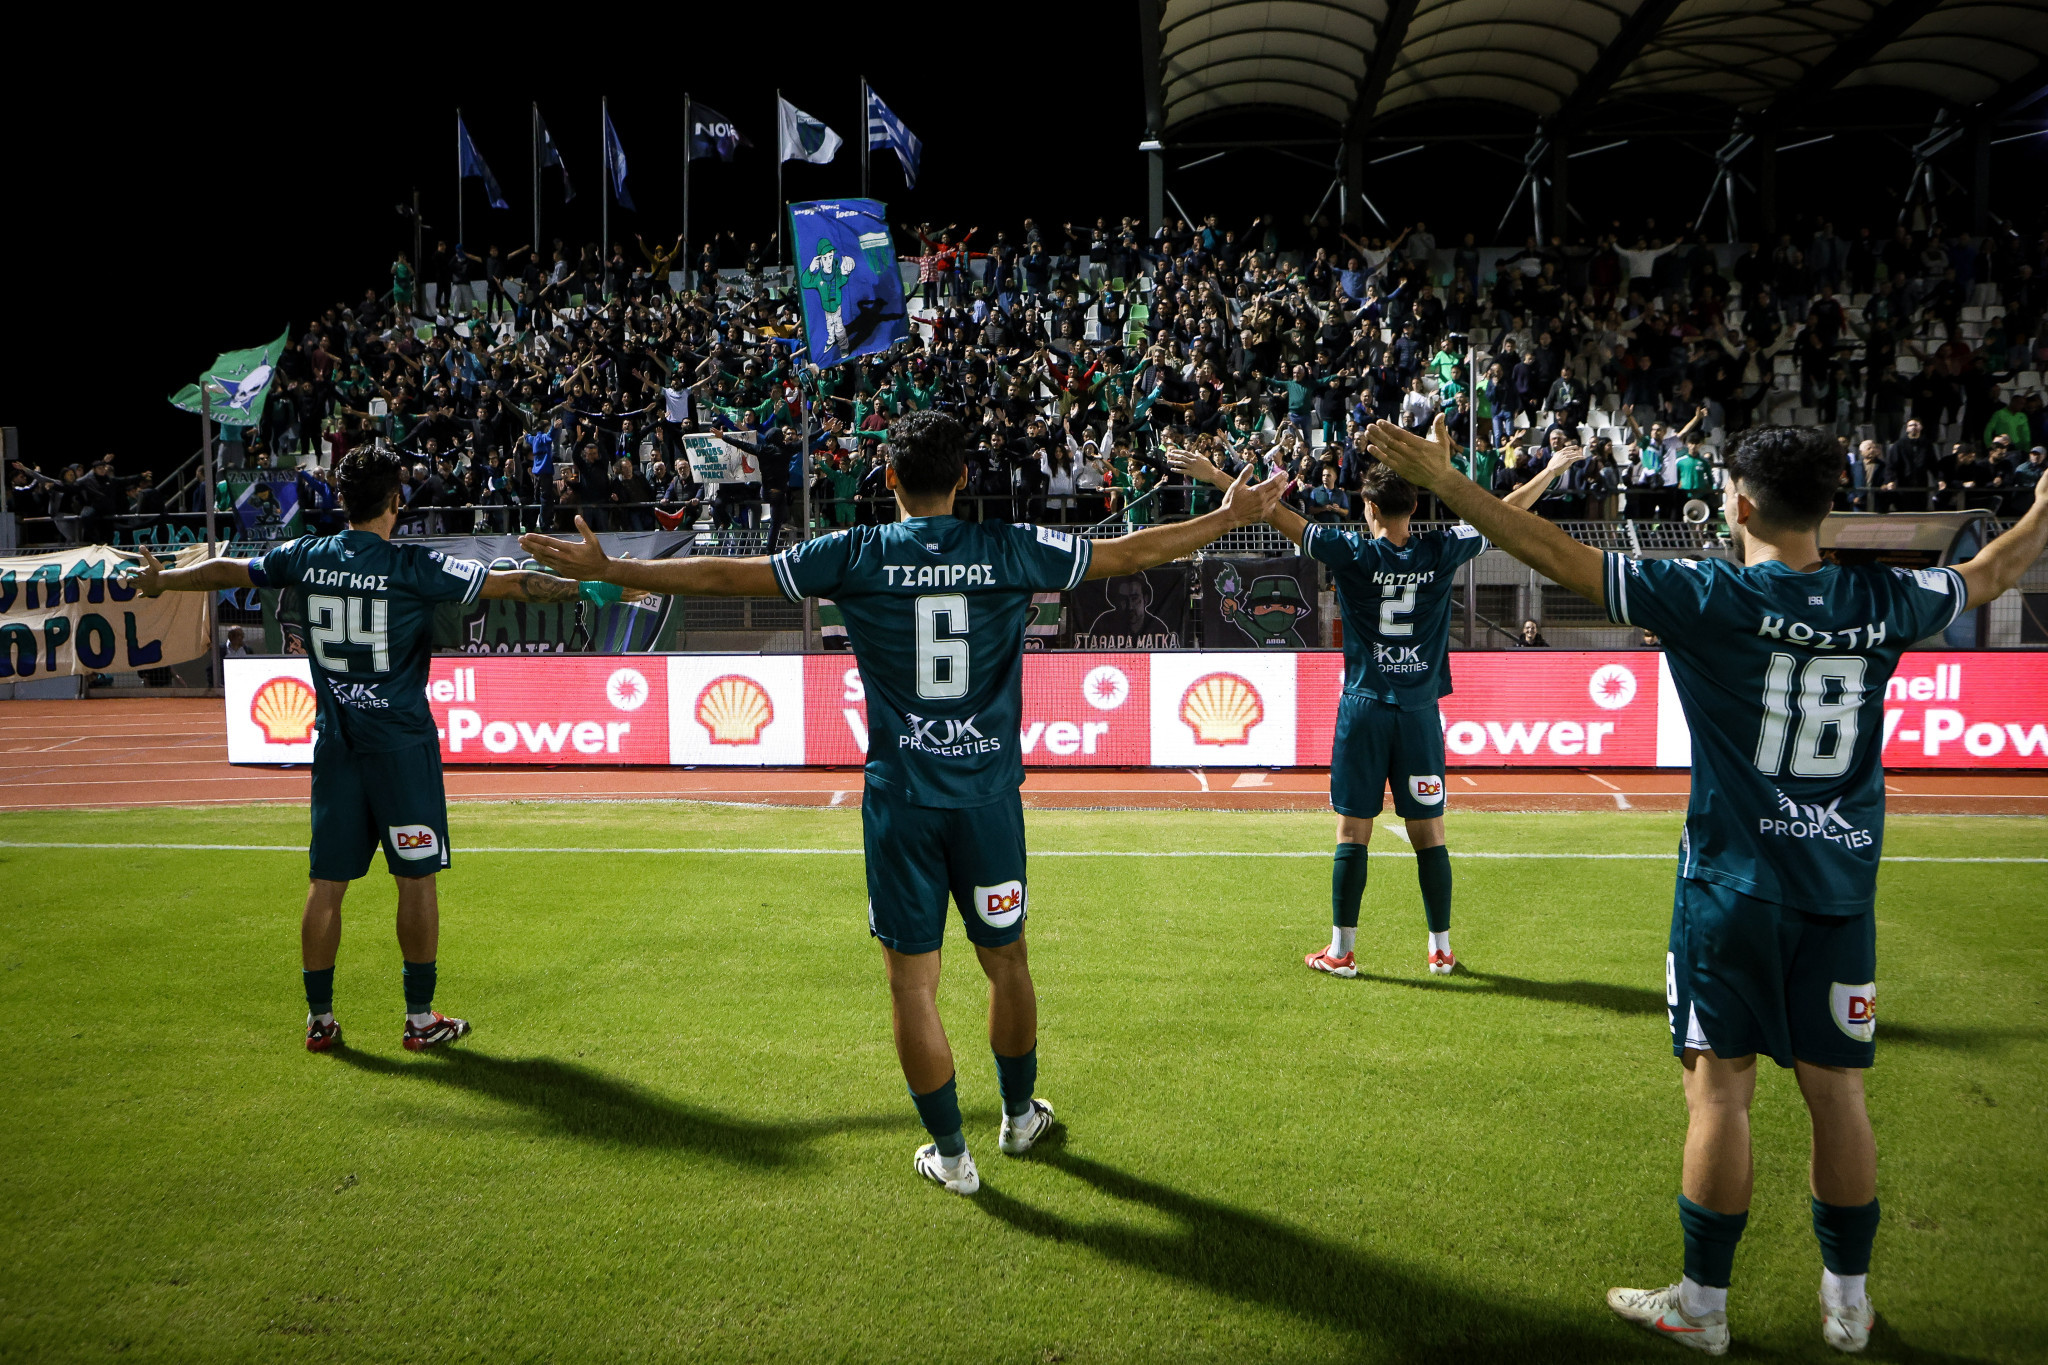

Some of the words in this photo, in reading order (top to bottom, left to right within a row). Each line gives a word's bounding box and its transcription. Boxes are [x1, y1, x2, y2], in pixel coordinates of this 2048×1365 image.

[302, 567, 389, 592] ΛΙΑΓΚΑΣ
[883, 564, 996, 587] ΤΣΑΠΡΑΣ
[1379, 583, 1418, 637] 2
[307, 593, 391, 674] 24
[915, 593, 970, 700] 6
[1757, 615, 1886, 650] ΚΩΣΤΗ
[905, 712, 985, 747] KJK
[1754, 652, 1868, 778] 18
[1418, 780, 1441, 796] Dole
[397, 830, 433, 848] Dole
